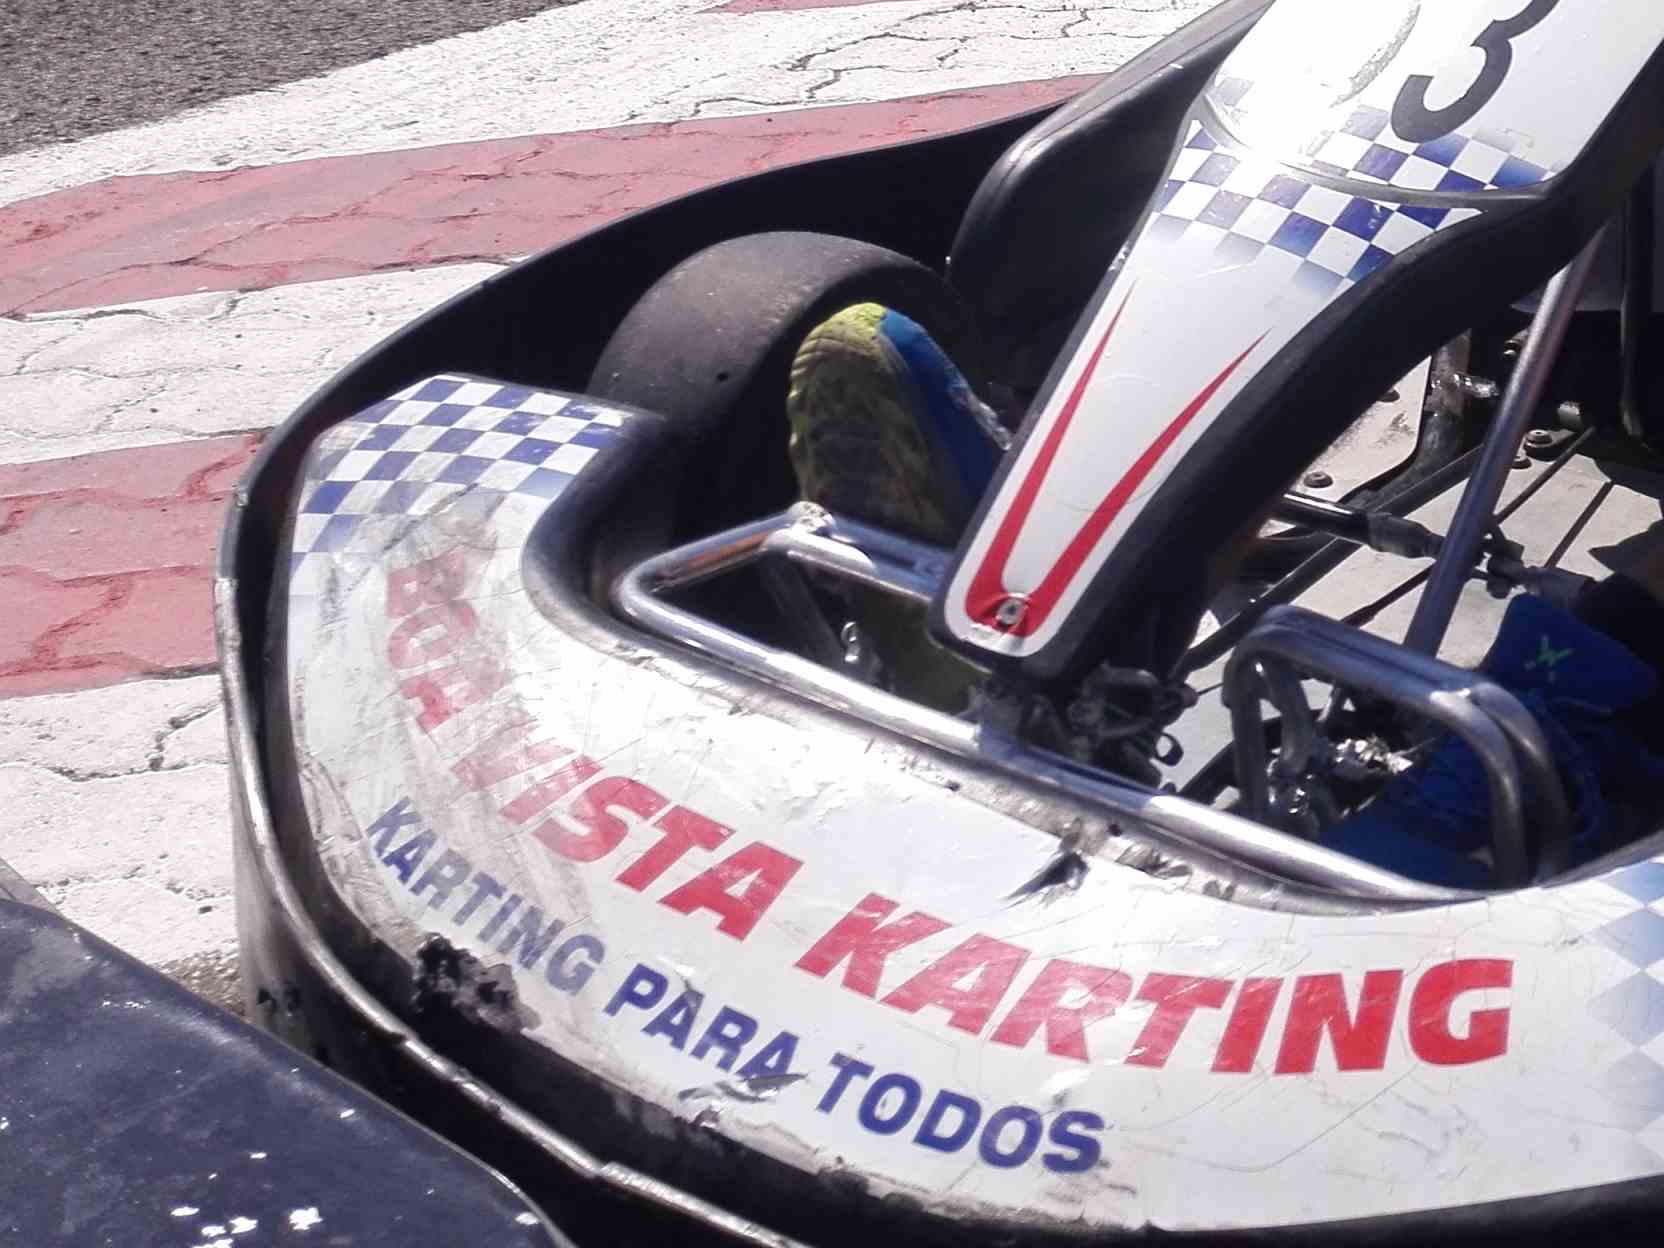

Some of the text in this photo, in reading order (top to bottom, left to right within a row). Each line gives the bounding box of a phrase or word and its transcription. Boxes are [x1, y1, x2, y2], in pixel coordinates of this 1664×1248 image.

[365, 797, 1106, 1173] KARTING PARA TODOS
[794, 892, 1514, 1076] KARTING
